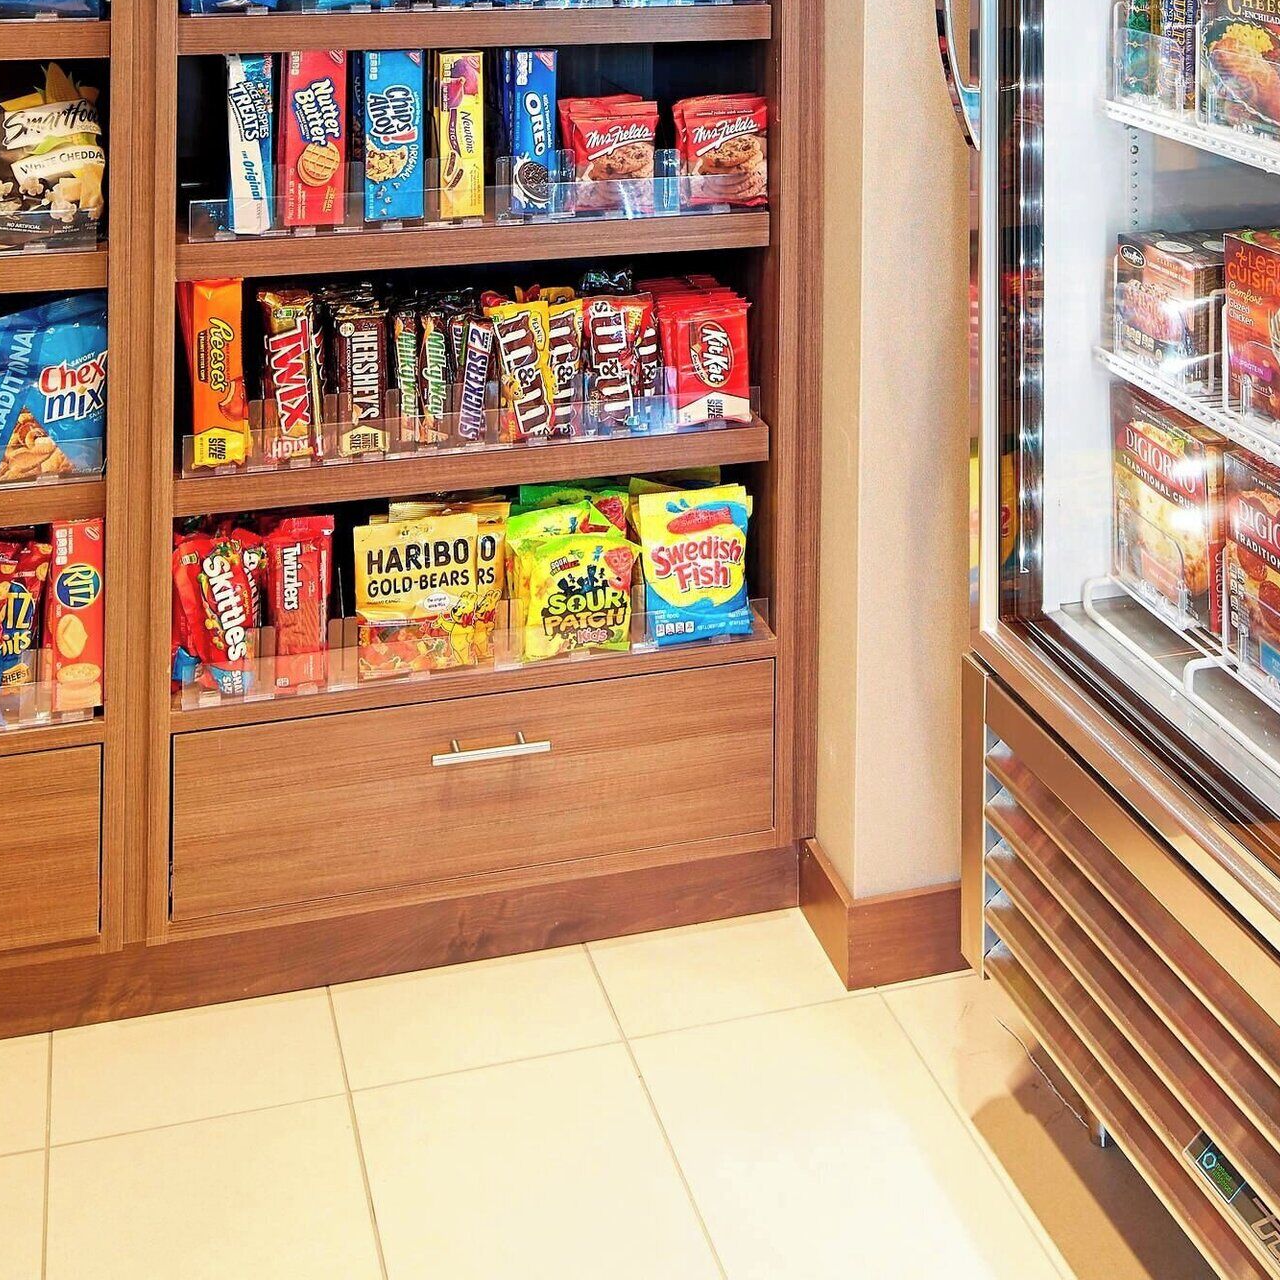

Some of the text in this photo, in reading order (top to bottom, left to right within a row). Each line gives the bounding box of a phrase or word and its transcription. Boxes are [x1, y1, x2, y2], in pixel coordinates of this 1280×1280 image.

[228, 82, 259, 142] TREATS
[460, 110, 474, 154] Newtons
[524, 92, 544, 156] OREO
[243, 160, 262, 200] Original
[1228, 283, 1263, 306] Comfort
[38, 351, 106, 395] Chex
[209, 316, 234, 392] Reese's
[352, 322, 379, 420] HERSHEY'S
[270, 316, 310, 437] TWIX
[459, 350, 488, 440] SNICKERS
[46, 385, 105, 423] mix
[208, 437, 218, 458] SIZE
[217, 438, 226, 460] KING
[1122, 455, 1170, 499] TRADITIONAL
[367, 538, 470, 575] HARIBO
[652, 536, 744, 577] Swedish
[282, 542, 302, 613] Twizzlers
[367, 570, 470, 598] GOLD-BEARS
[675, 562, 731, 593] Fish
[202, 556, 247, 662] Skittles
[544, 606, 625, 635] PATCH
[548, 590, 621, 615] SOUR
[576, 628, 608, 644] Kids
